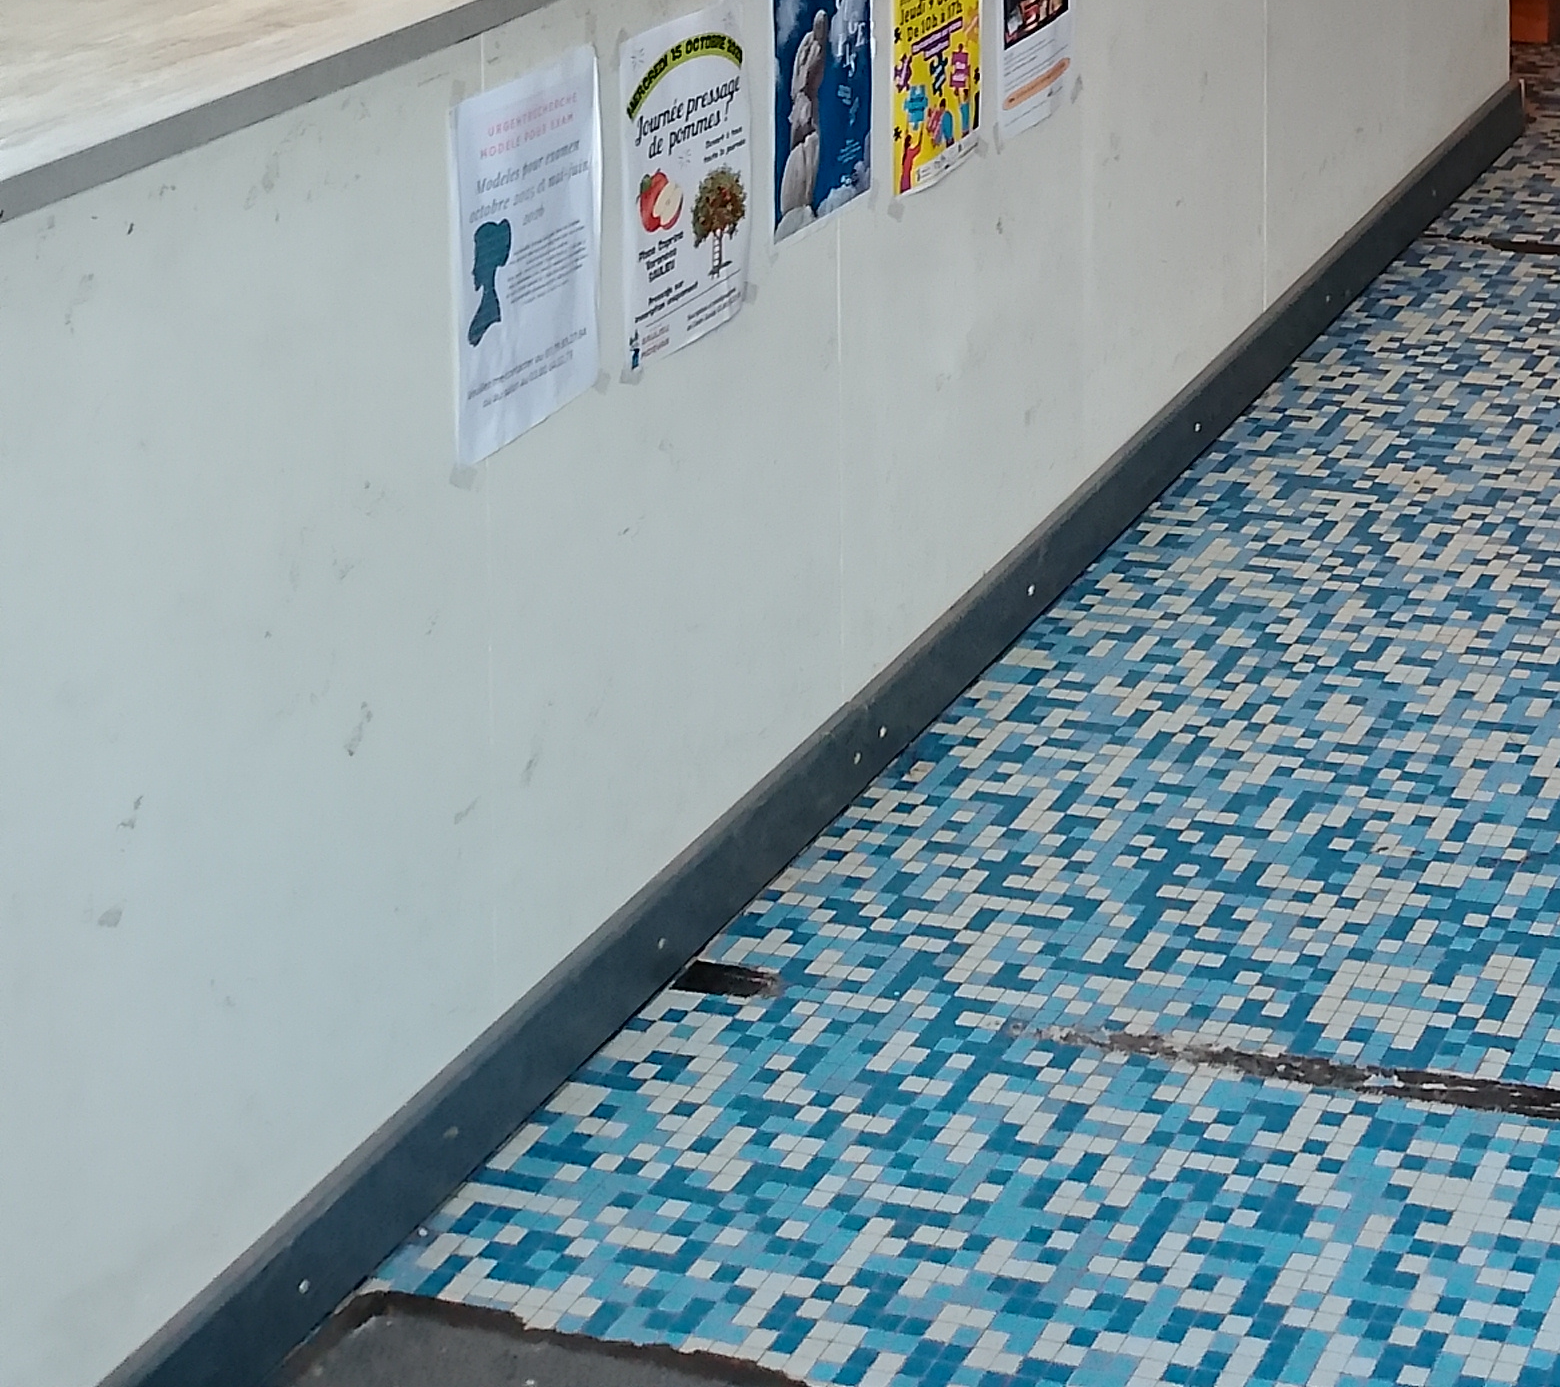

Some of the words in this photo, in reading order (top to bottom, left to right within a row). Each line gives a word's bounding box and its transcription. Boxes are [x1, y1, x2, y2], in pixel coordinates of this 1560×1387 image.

[906, 26, 919, 43] De
[626, 54, 669, 120] MERCREDI
[670, 43, 682, 62] 15
[685, 34, 727, 56] OCTOBRE
[634, 98, 684, 148] Journée
[684, 75, 741, 123] pressage
[479, 134, 521, 160] MODELE
[647, 134, 664, 160] de
[469, 197, 511, 224] octobre
